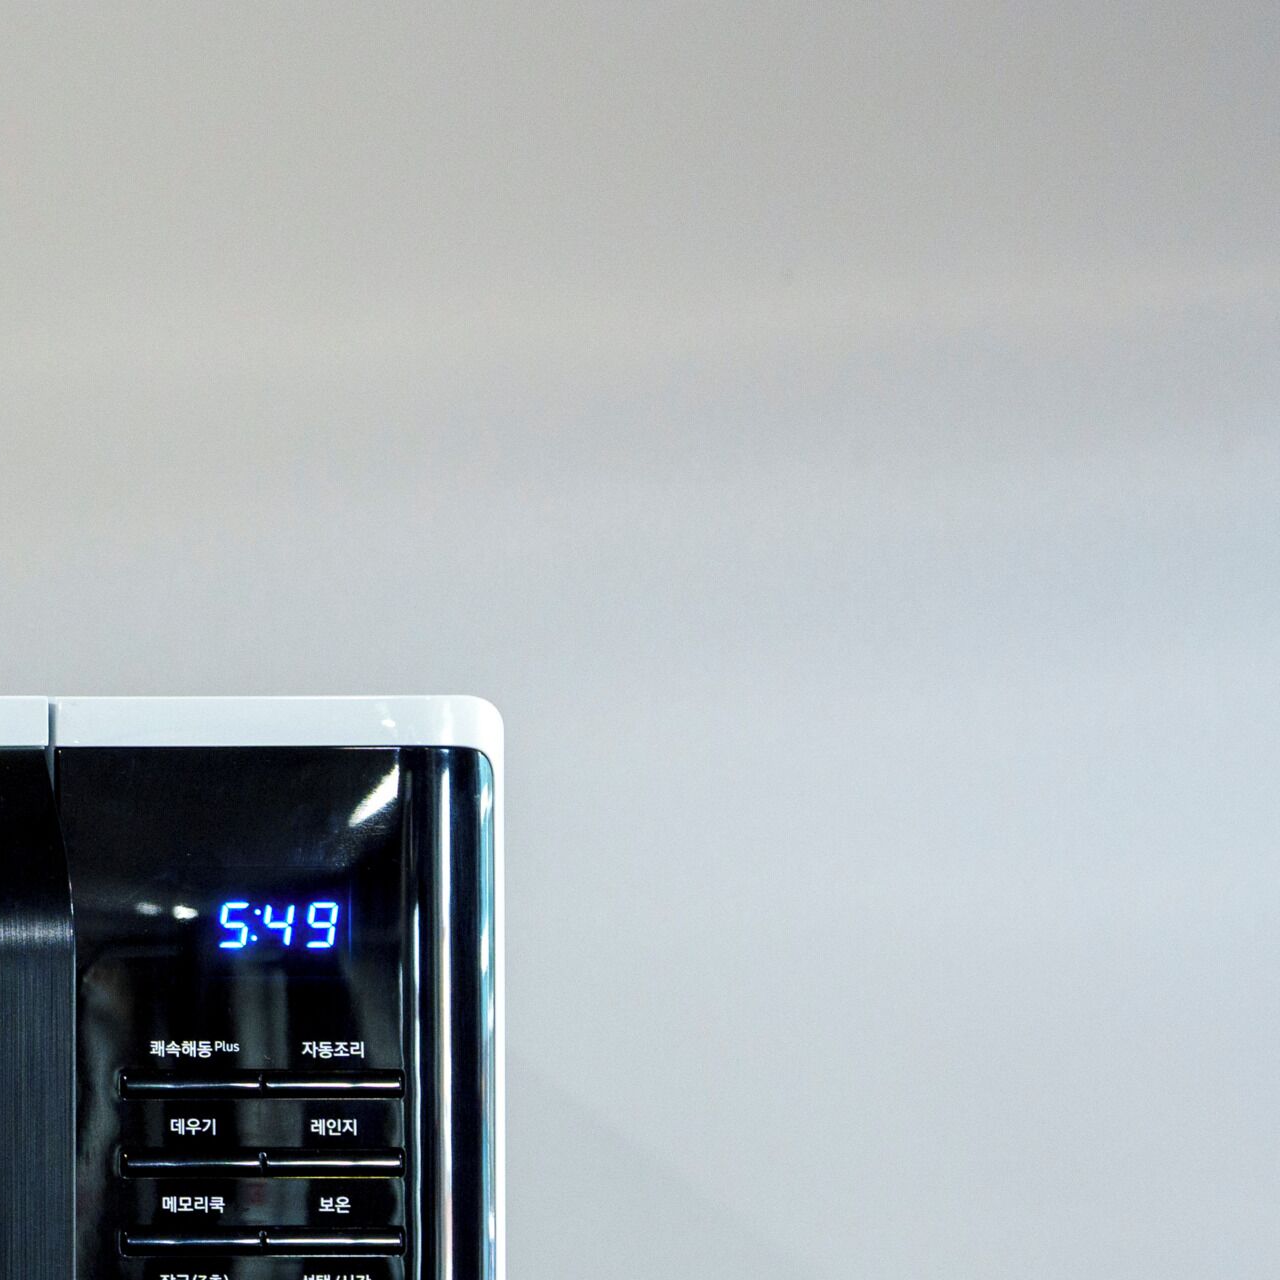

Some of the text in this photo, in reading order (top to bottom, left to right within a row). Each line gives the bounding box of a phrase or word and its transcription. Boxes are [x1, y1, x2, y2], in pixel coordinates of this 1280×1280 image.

[218, 901, 339, 949] 5:49
[301, 1040, 365, 1059] 자동조리
[170, 1118, 217, 1136] 데우기
[310, 1118, 358, 1137] 레인지
[161, 1196, 226, 1214] 메모리쿡
[318, 1196, 352, 1214] 보온
